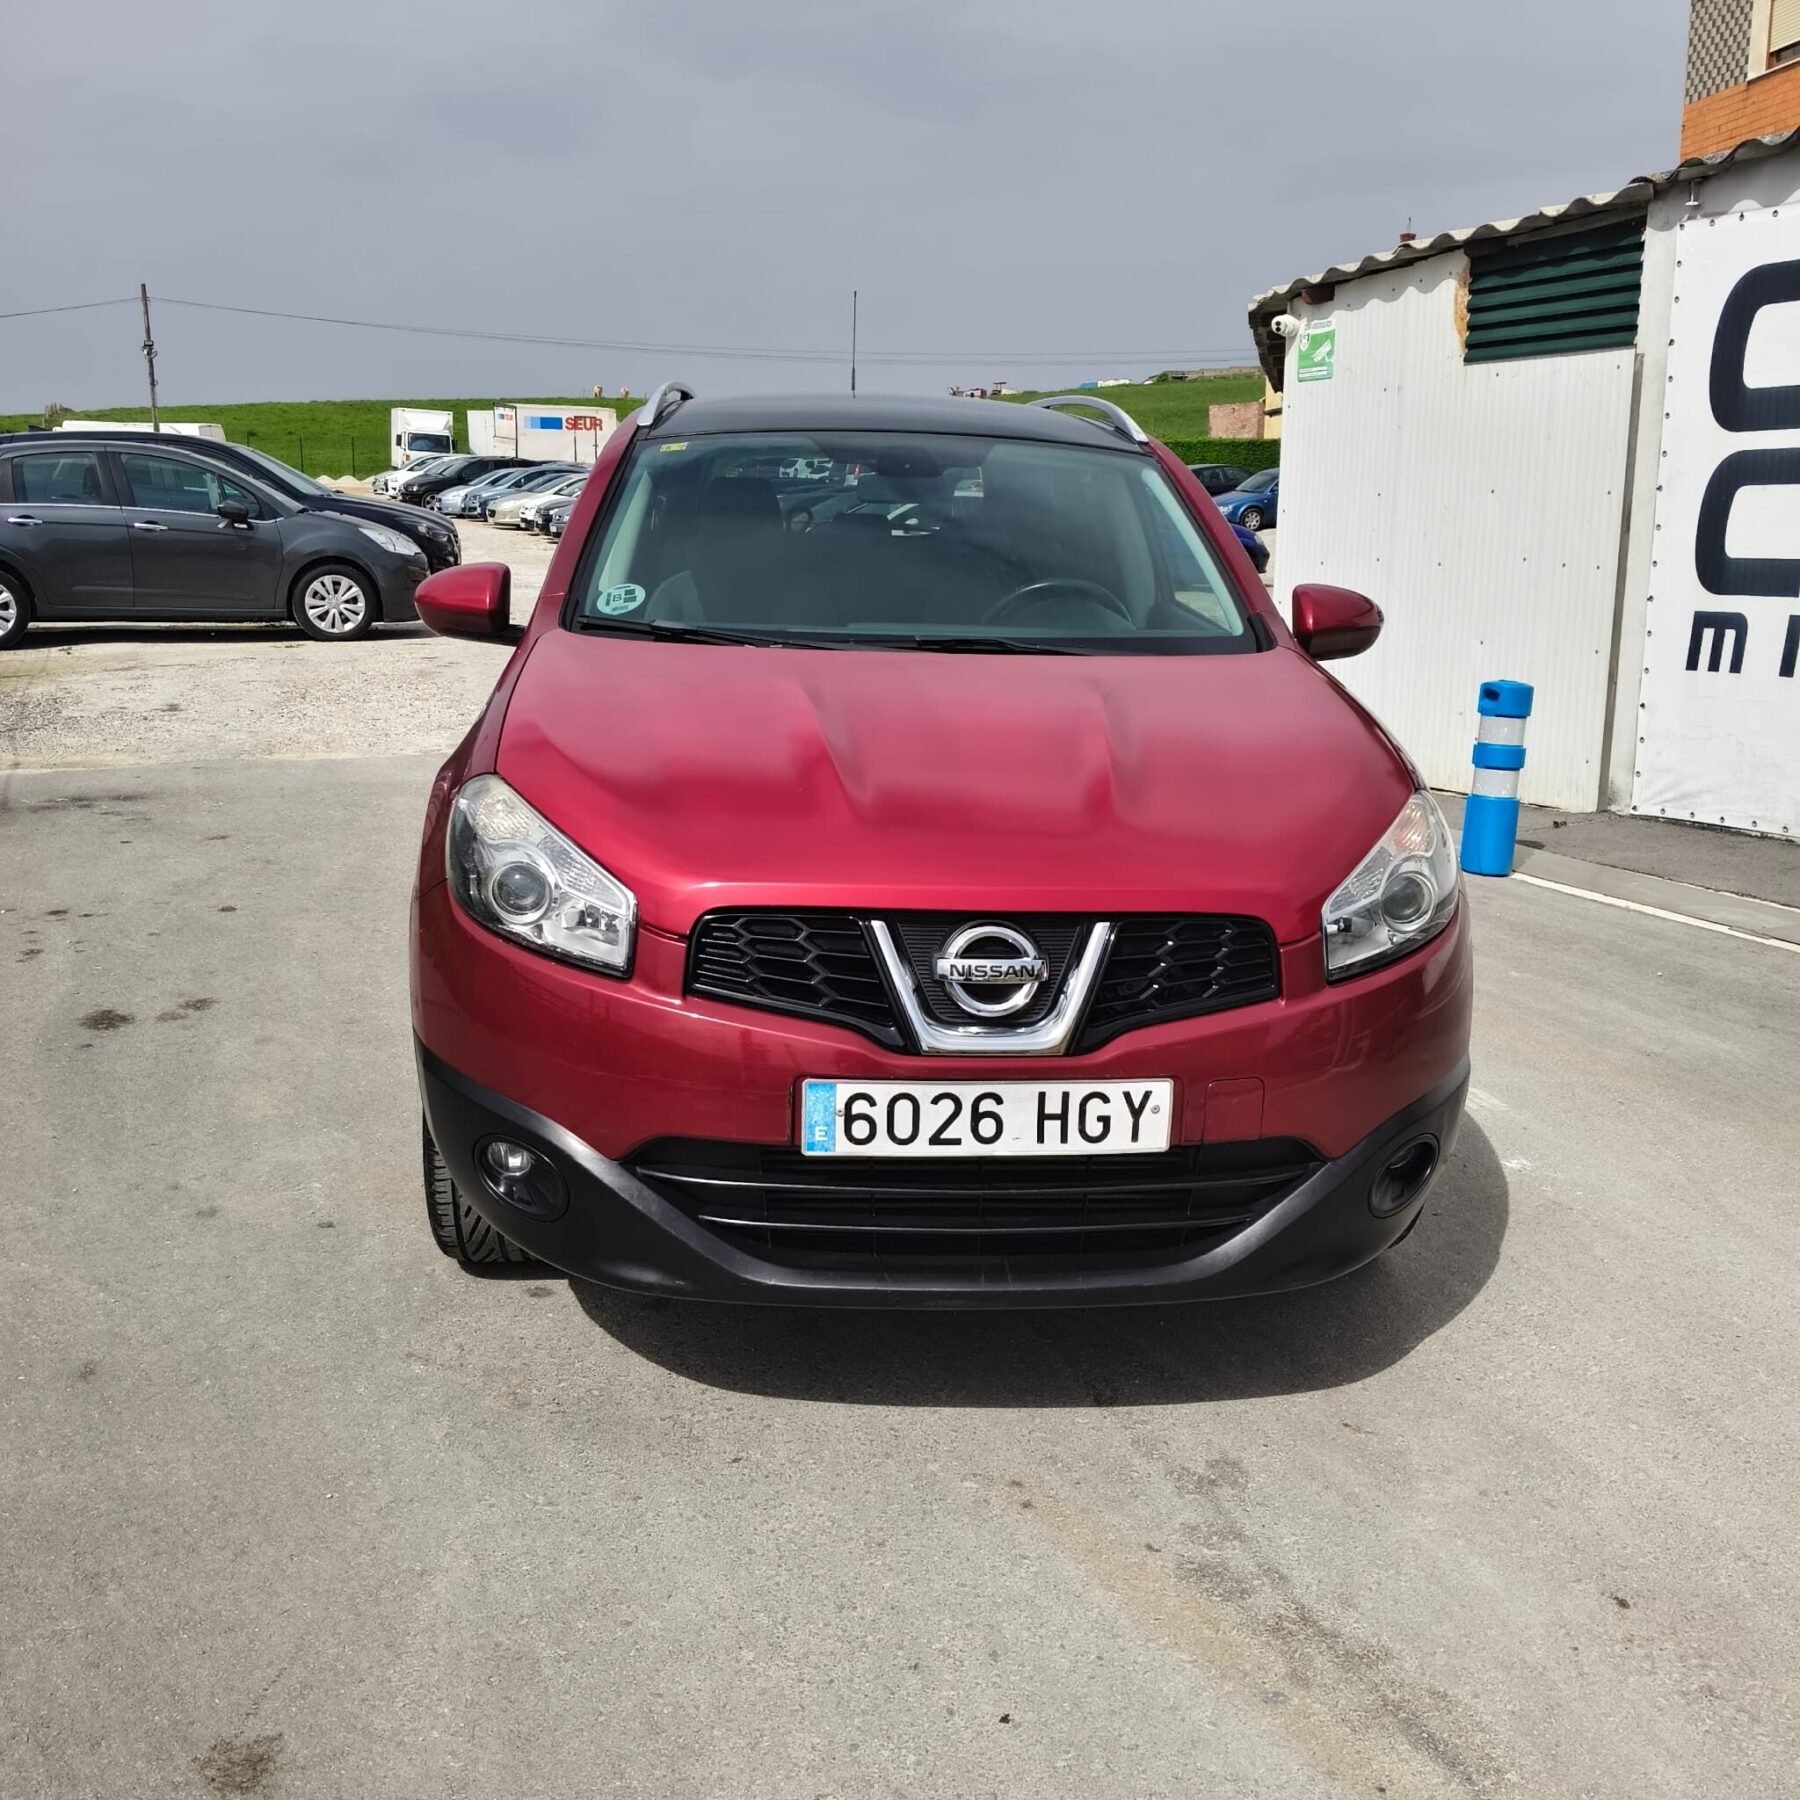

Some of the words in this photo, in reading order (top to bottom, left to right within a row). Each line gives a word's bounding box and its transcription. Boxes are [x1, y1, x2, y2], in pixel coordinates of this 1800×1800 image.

[565, 417, 603, 431] SEUR
[949, 964, 1035, 978] NISSAN
[843, 1091, 1004, 1146] 6026
[1036, 1090, 1153, 1145] HGY
[815, 1125, 828, 1141] E
